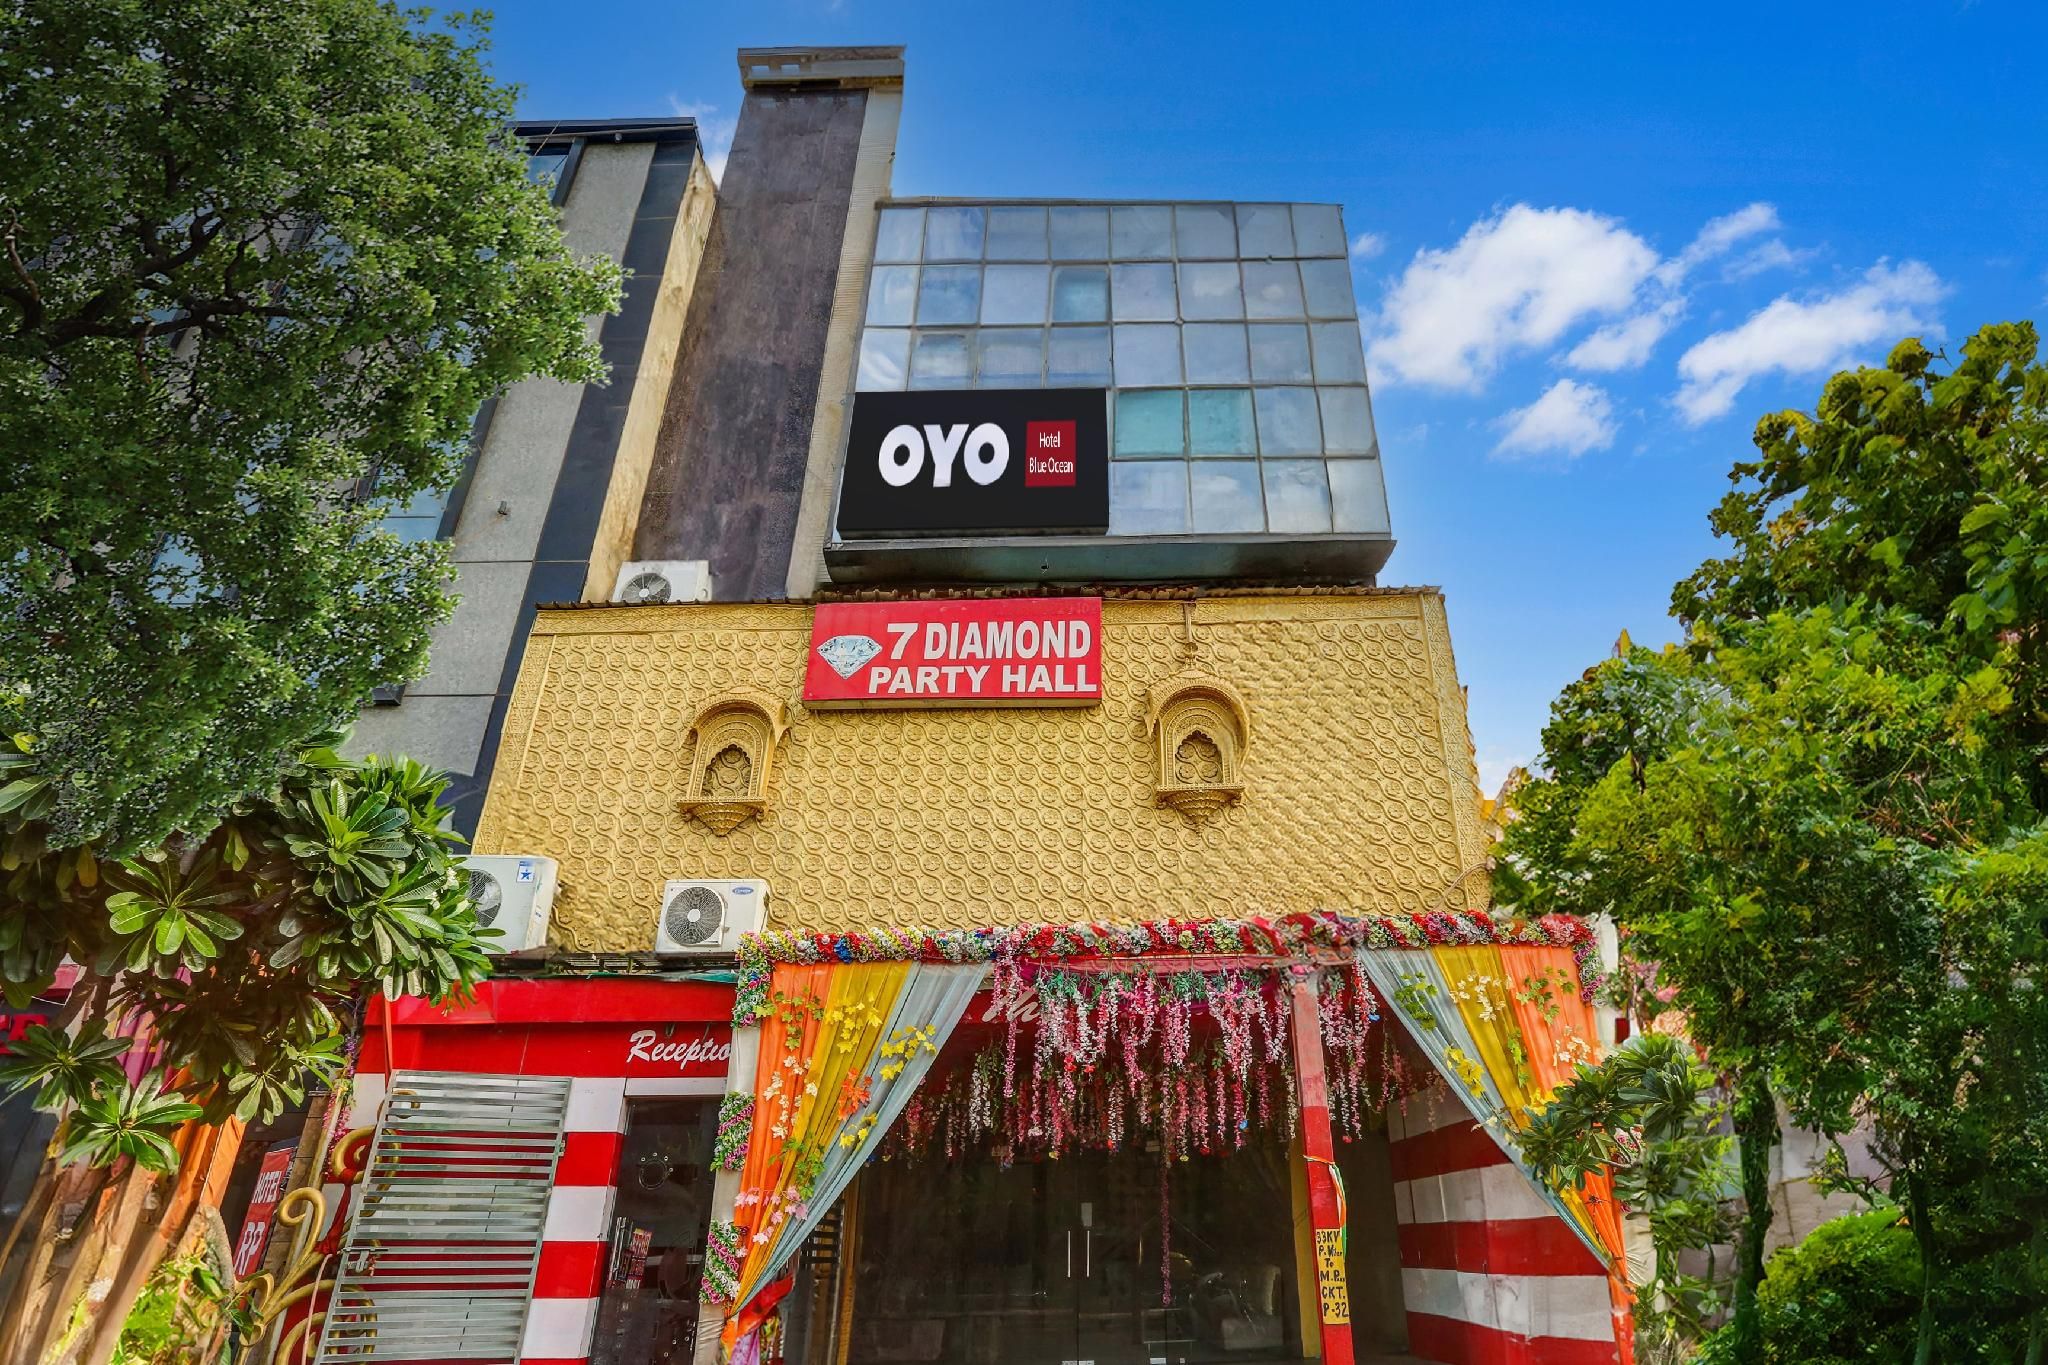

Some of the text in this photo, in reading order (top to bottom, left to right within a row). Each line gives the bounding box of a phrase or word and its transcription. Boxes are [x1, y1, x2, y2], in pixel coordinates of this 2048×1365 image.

[878, 422, 1009, 487] OYO
[1039, 430, 1061, 448] Hotel
[1029, 456, 1074, 473] Blue Ocean
[887, 620, 1091, 660] 7 DIAMOND
[868, 663, 1097, 694] PARTY HALL
[626, 1029, 732, 1070] Receptio
